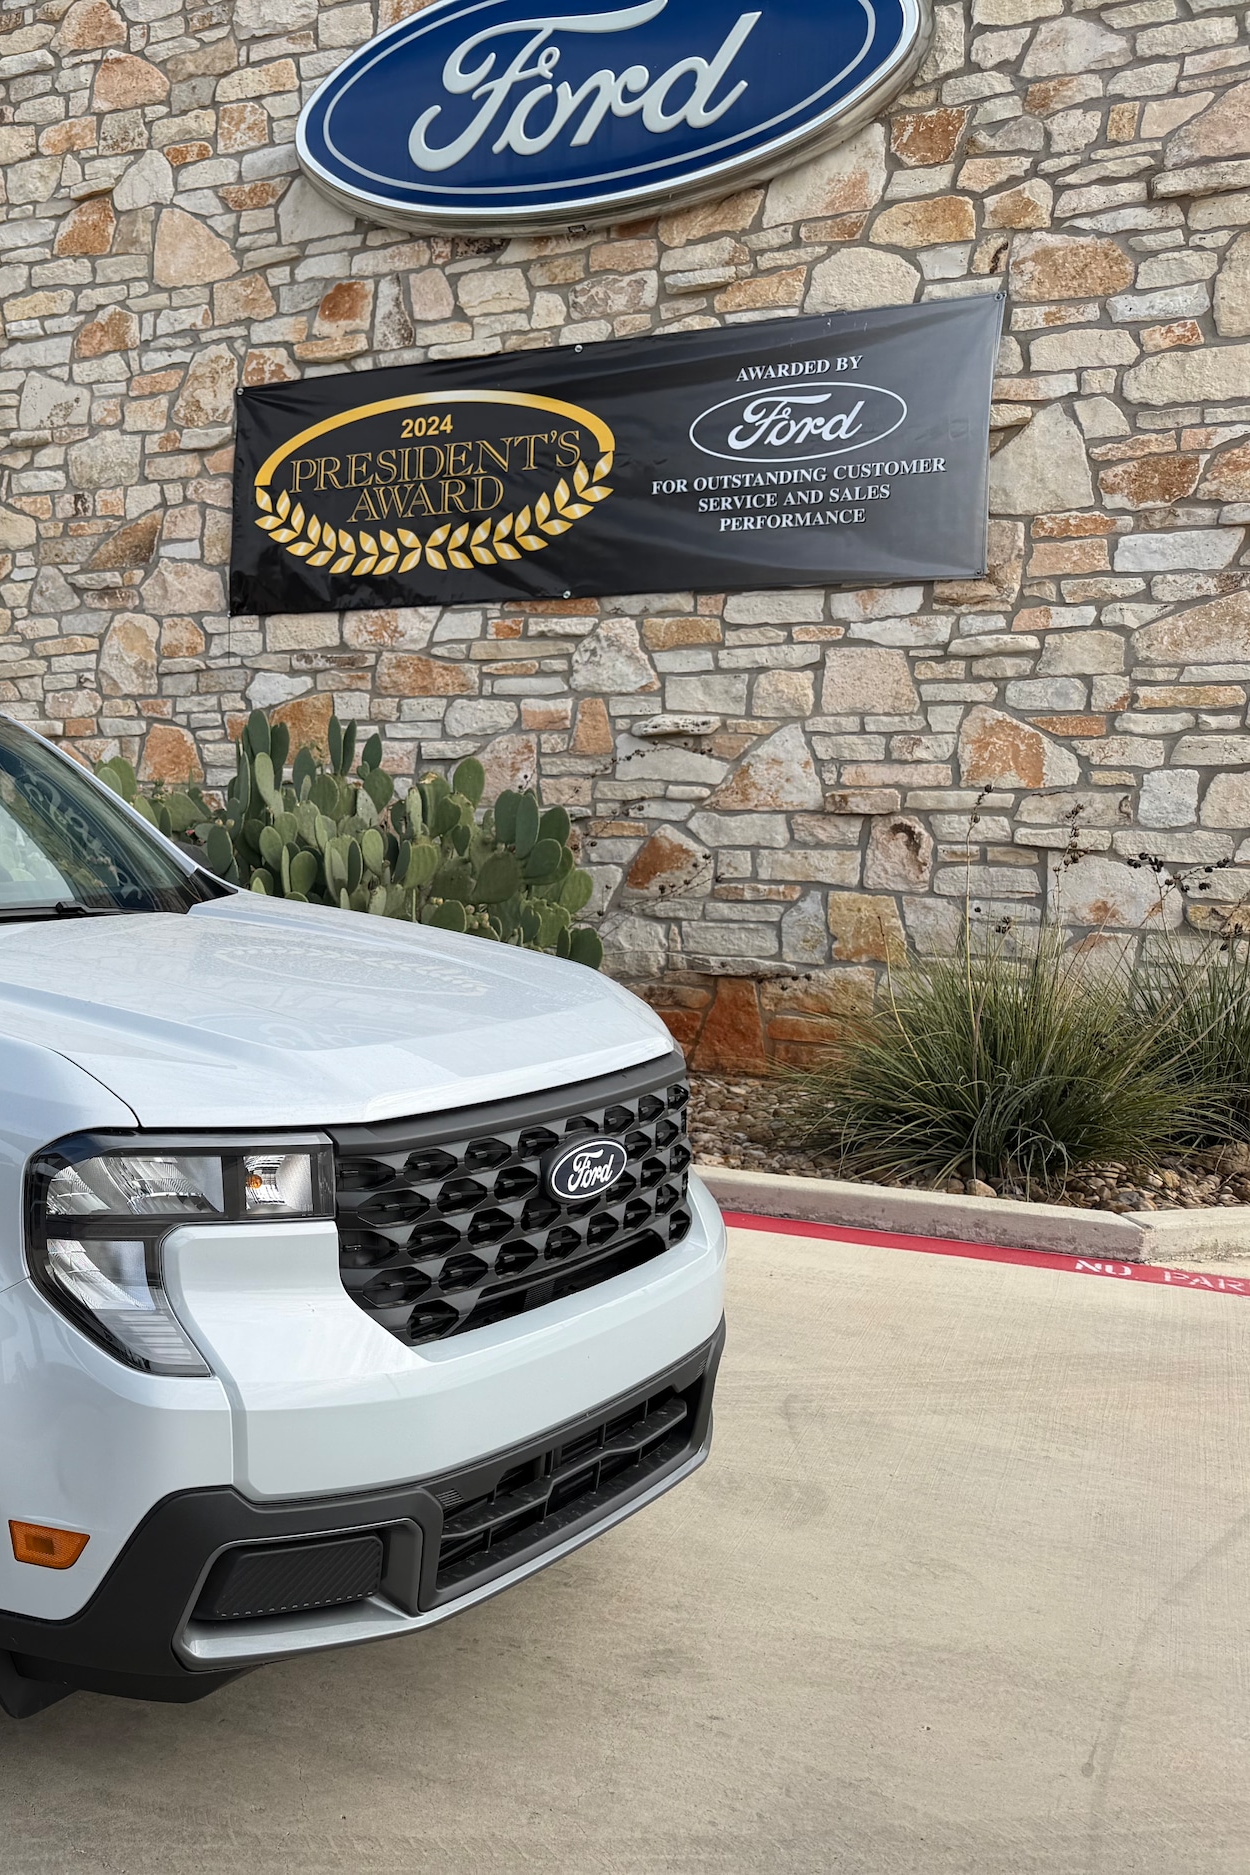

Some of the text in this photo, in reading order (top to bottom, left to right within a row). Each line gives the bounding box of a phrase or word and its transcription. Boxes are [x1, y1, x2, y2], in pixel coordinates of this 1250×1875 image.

[408, 0, 762, 172] Ford
[736, 355, 863, 382] AWARDED BY
[400, 413, 453, 440] 2024
[727, 393, 865, 450] Ford
[651, 457, 946, 495] FOR OUTSTANDING CUSTOMER
[347, 476, 505, 523] AWARD
[698, 484, 891, 513] SERVICE AND SALES
[719, 508, 866, 532] PERFORMANCE
[567, 1149, 614, 1192] Ford
[1075, 1259, 1132, 1277] NO
